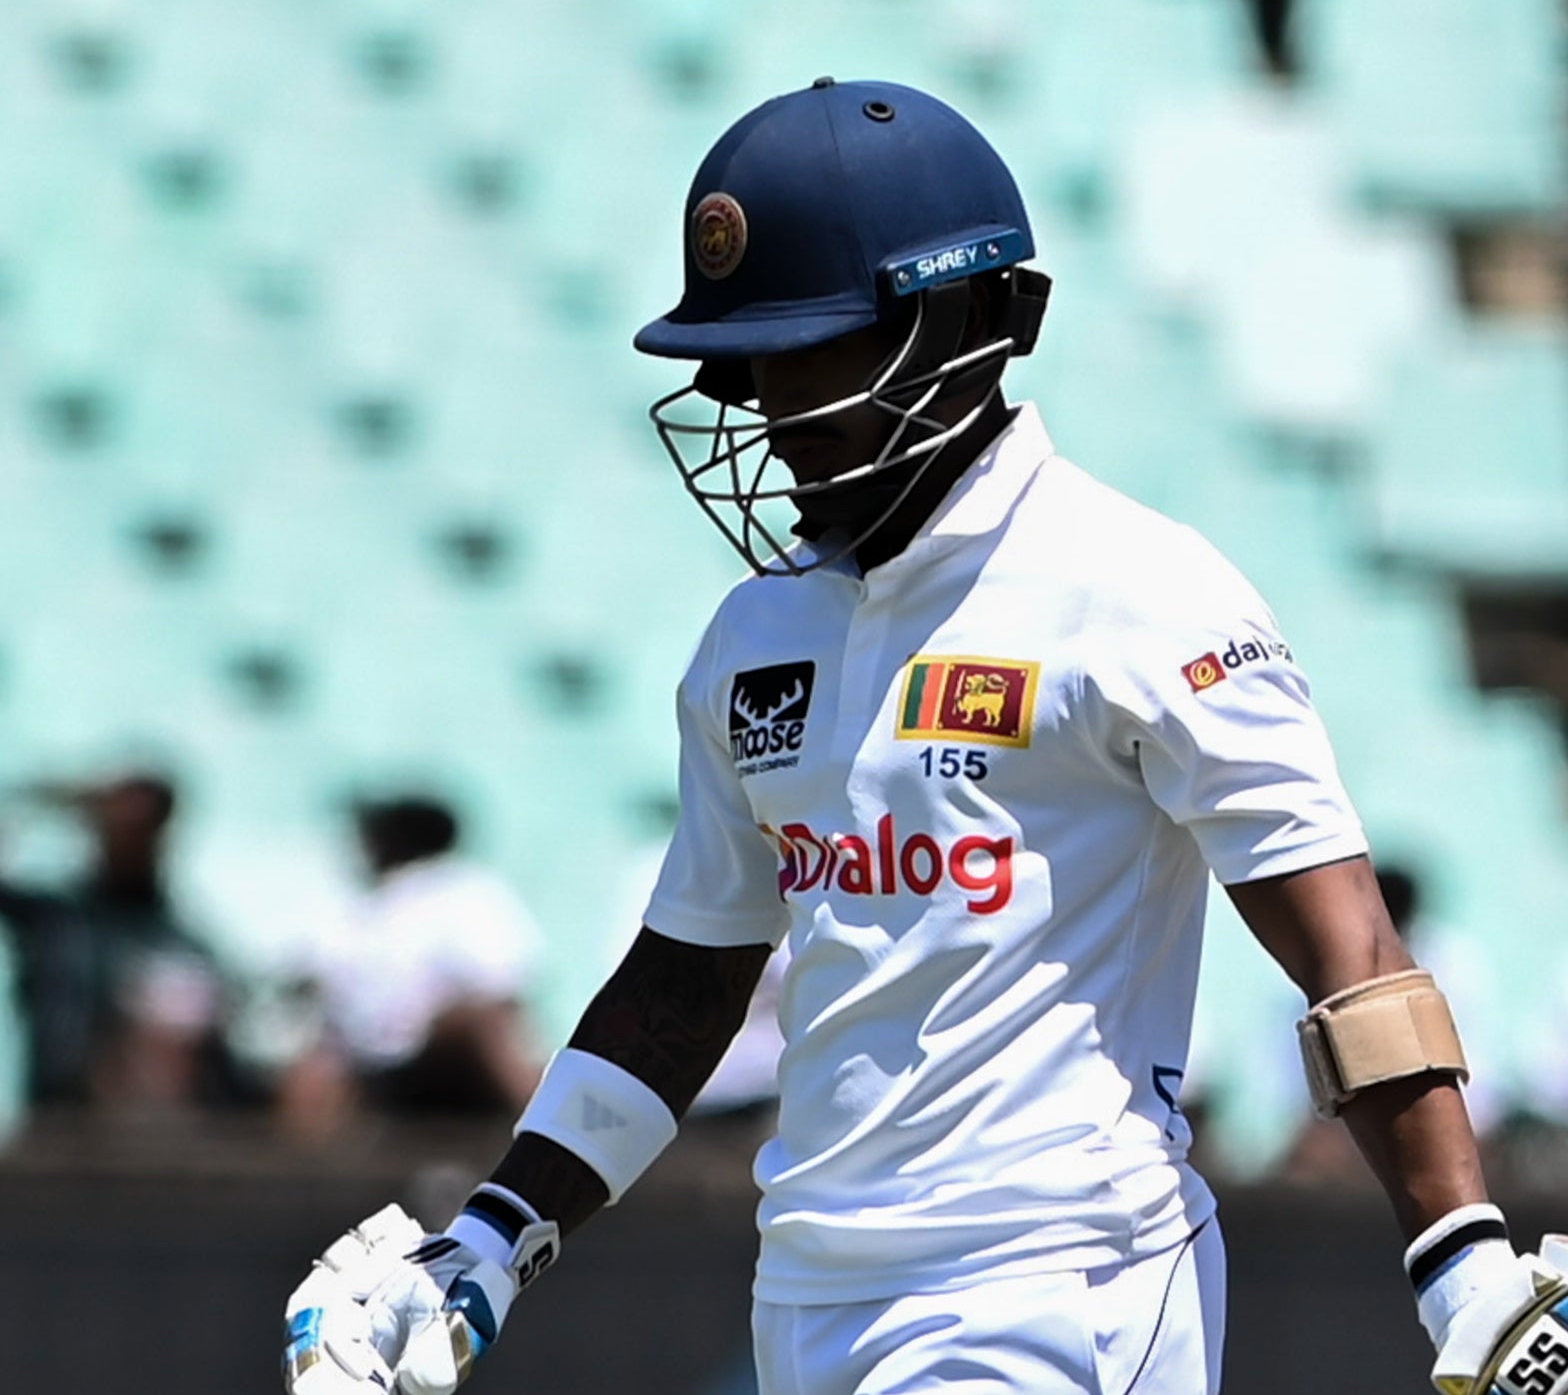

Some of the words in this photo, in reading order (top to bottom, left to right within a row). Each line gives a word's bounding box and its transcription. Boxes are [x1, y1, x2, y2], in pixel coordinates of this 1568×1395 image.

[915, 246, 978, 279] SHREY
[919, 746, 988, 781] 155
[781, 812, 1014, 915] Dialog
